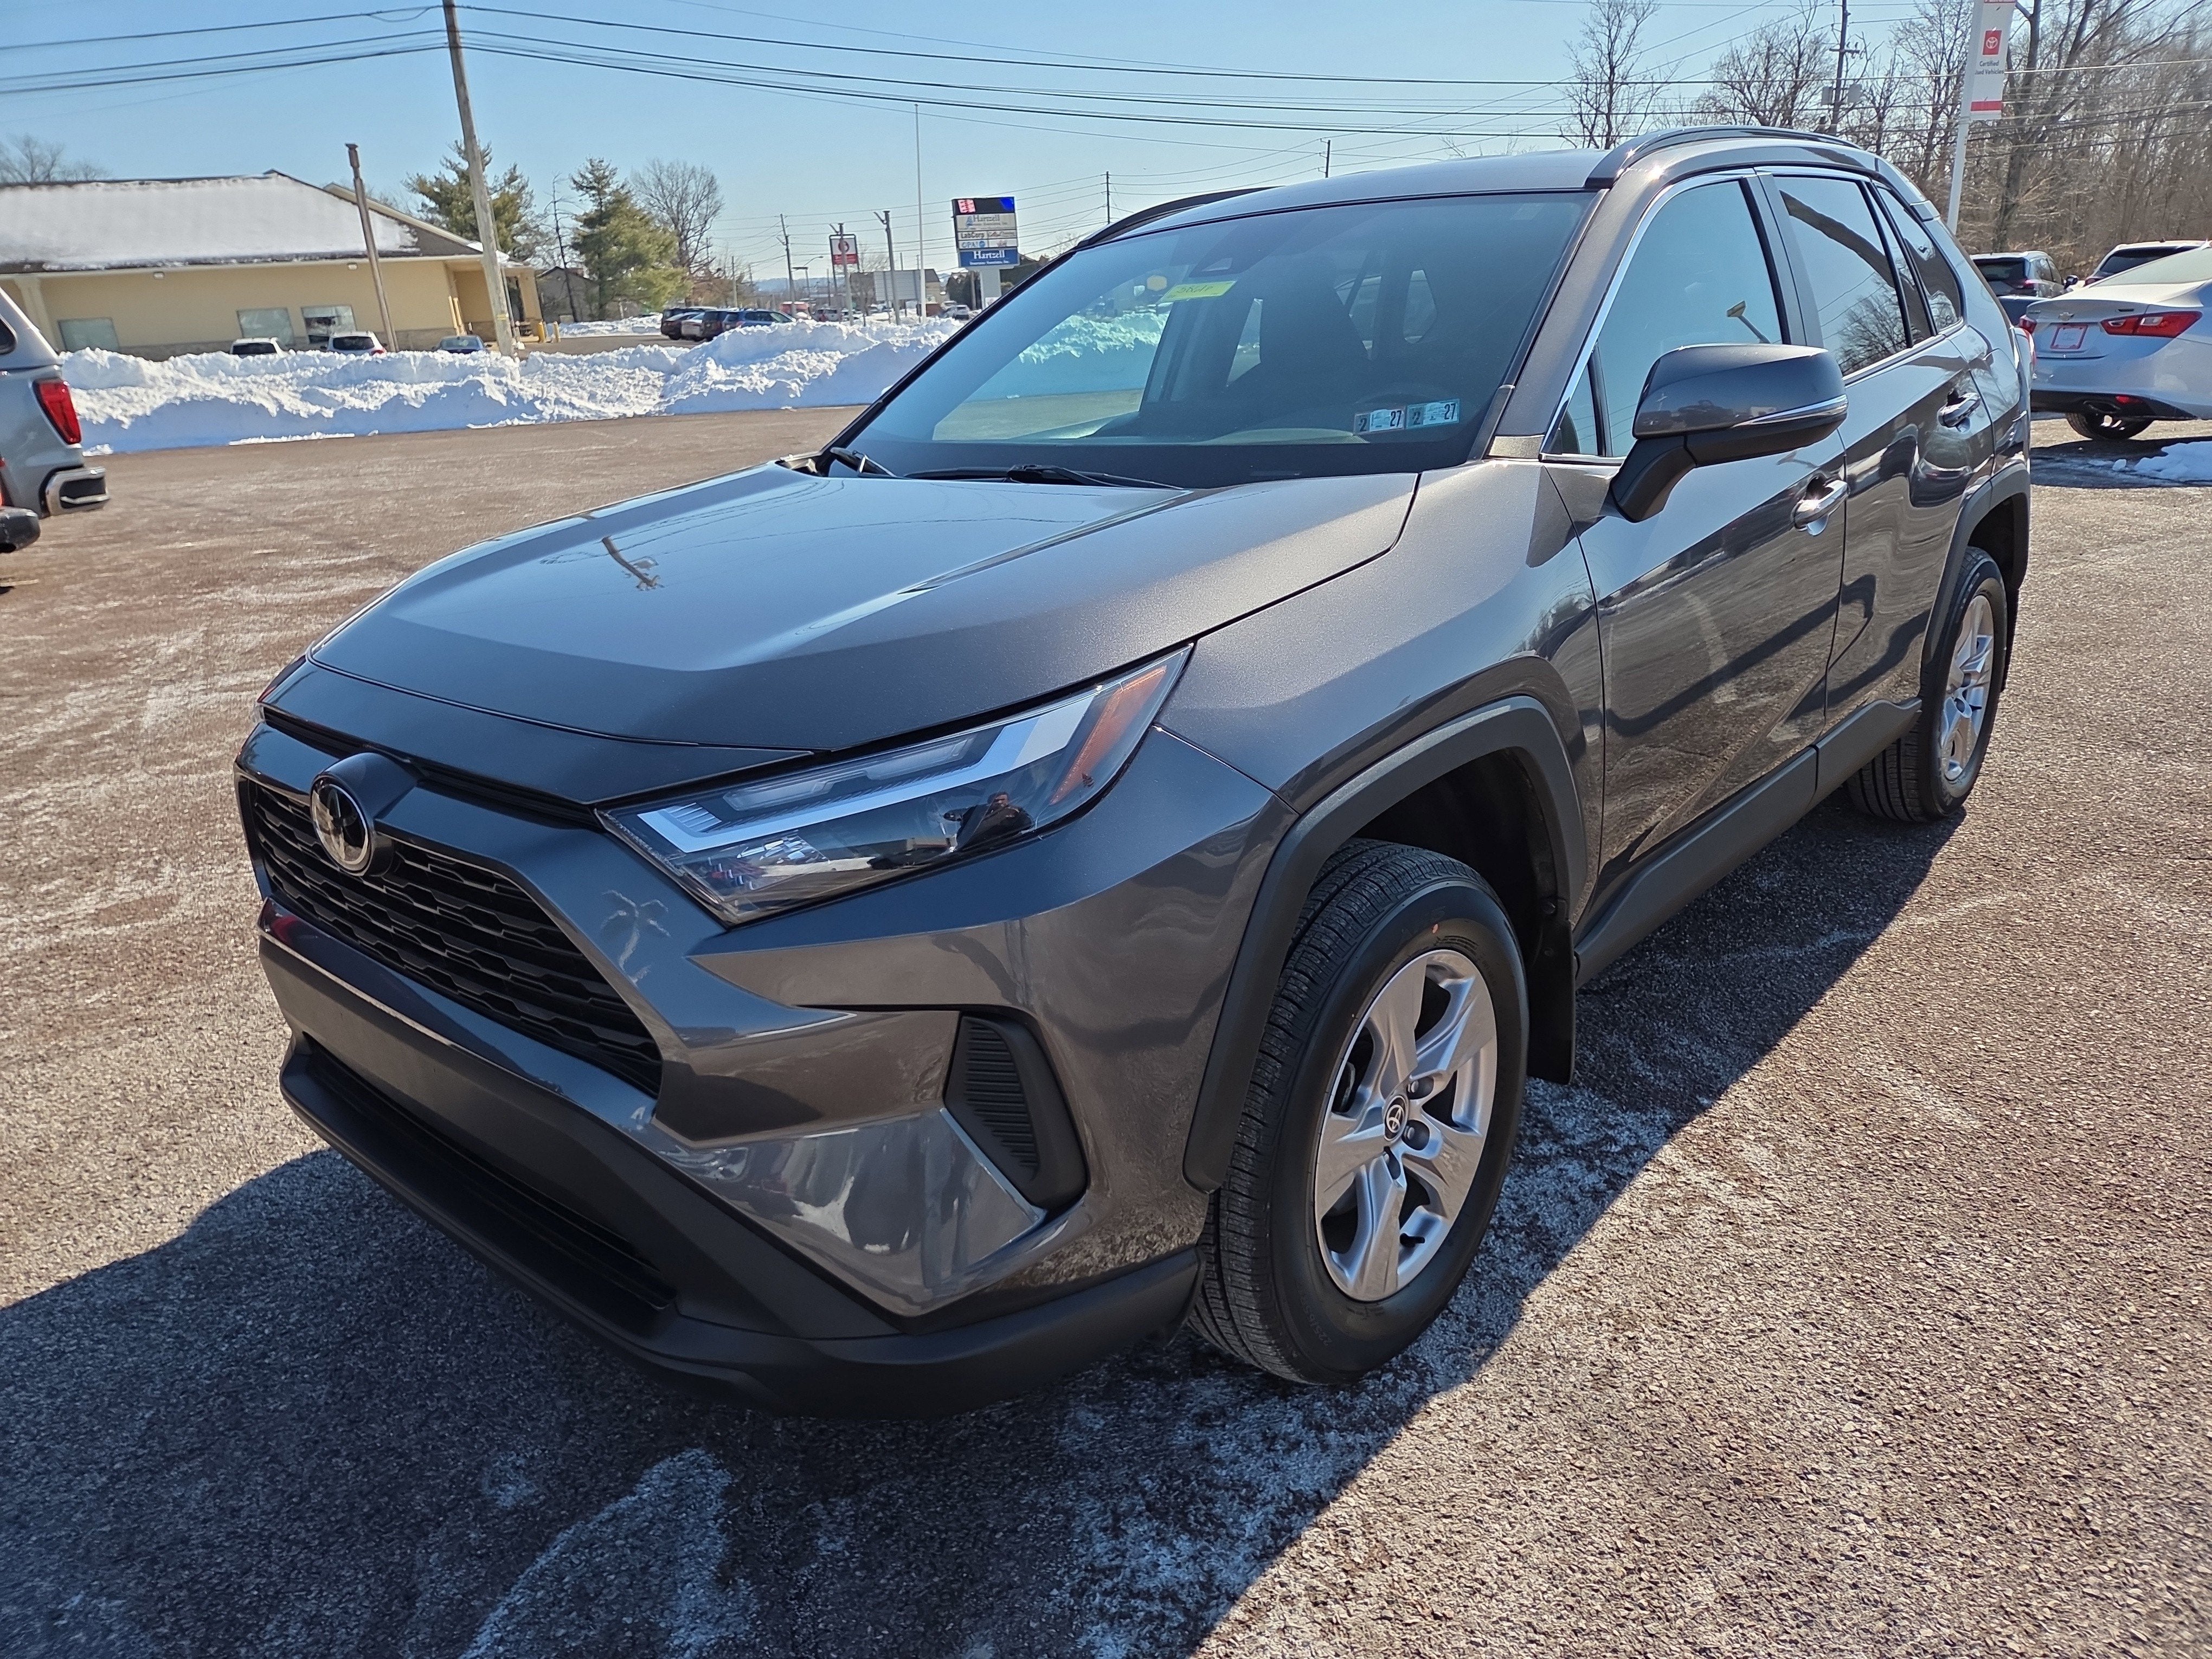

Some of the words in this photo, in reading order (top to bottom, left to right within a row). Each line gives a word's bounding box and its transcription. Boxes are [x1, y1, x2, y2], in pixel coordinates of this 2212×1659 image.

[973, 249, 1005, 260] Hartzell
[1390, 410, 1402, 427] 27
[1444, 402, 1456, 420] 27
[1359, 417, 1368, 432] 2
